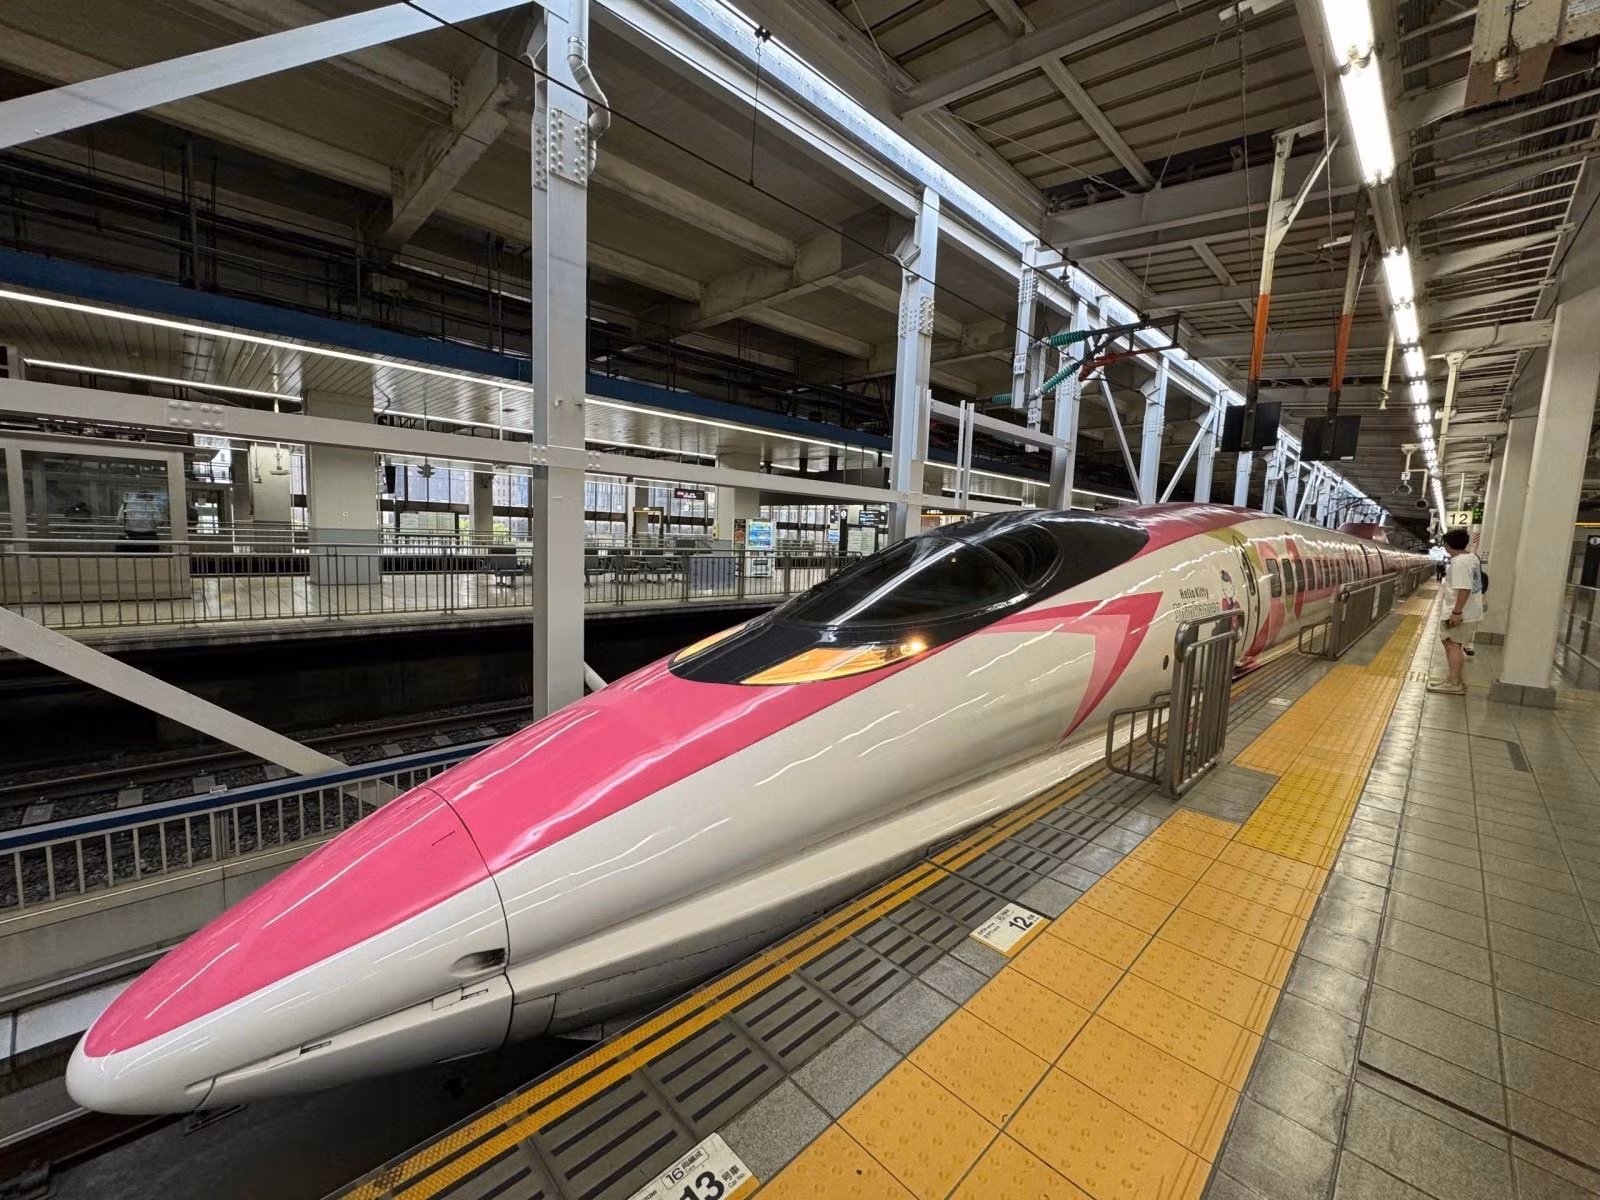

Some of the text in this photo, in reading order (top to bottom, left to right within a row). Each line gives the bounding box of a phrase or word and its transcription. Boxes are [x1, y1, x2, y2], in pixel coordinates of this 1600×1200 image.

[1450, 513, 1468, 525] 12
[1179, 587, 1209, 600] Hello Kitty
[1008, 916, 1034, 931] 12
[680, 1170, 725, 1200] 13
